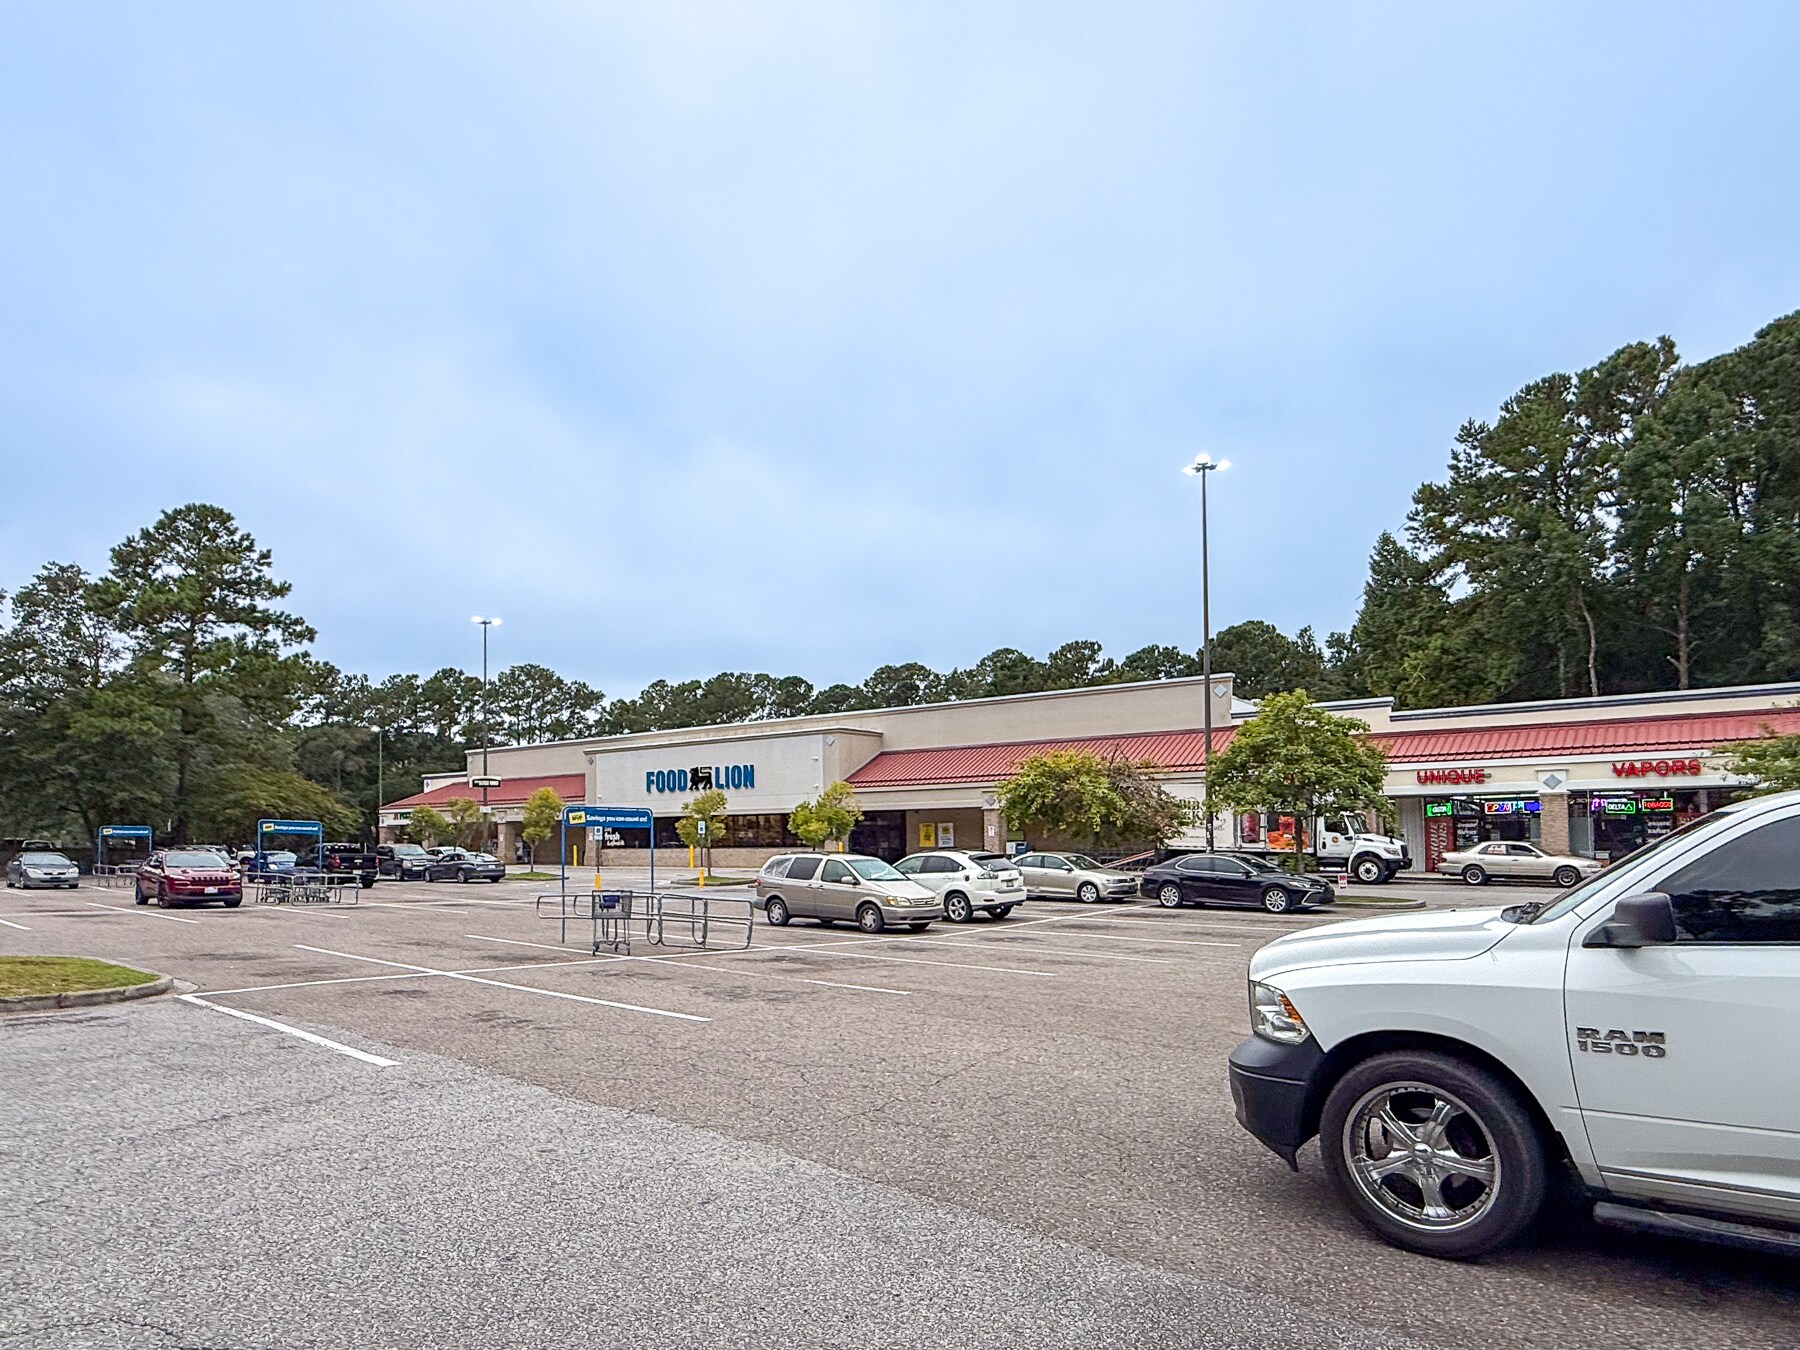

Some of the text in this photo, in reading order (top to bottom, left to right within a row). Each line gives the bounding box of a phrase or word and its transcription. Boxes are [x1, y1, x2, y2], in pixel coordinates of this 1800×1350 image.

[1416, 768, 1486, 785] UNIQUE
[1612, 759, 1701, 777] VAPORS
[646, 764, 755, 793] FOOD LION
[1608, 802, 1625, 810] DELTA
[1643, 801, 1672, 809] TOBACCO
[586, 814, 606, 822] Savings
[604, 832, 620, 841] fresh
[1576, 1025, 1666, 1044] RAM
[1577, 1040, 1666, 1058] 1500
